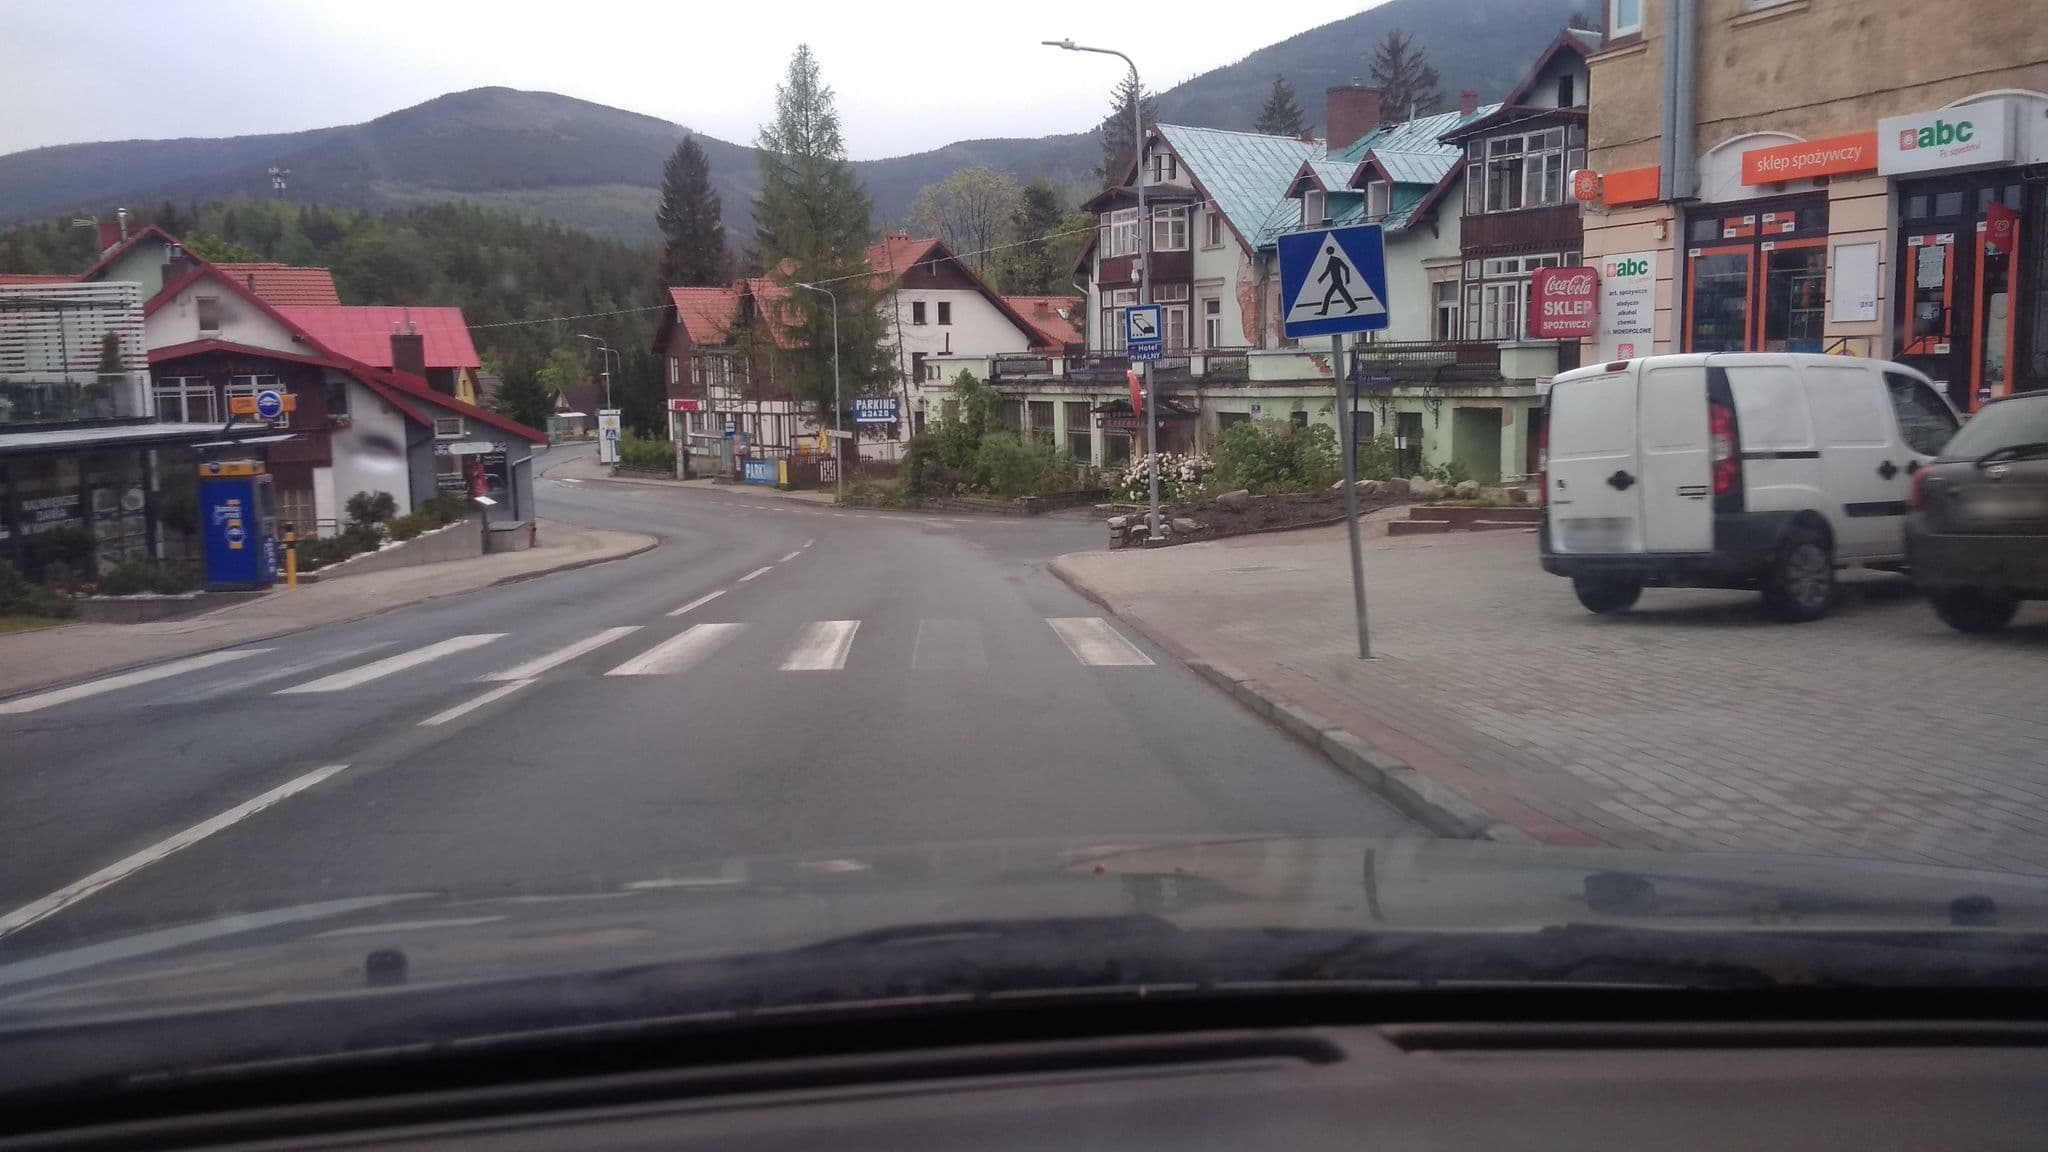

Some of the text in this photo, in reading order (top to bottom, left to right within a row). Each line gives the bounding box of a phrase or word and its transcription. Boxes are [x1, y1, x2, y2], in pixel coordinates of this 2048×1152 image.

[1918, 120, 1974, 149] abc
[1757, 146, 1862, 172] sklep spożywczy
[1616, 258, 1649, 277] abc
[1544, 275, 1593, 296] Coca-Cola
[1544, 301, 1593, 316] SKLEP
[1543, 320, 1592, 330] SPOŻYWCZY
[1138, 343, 1158, 352] Hotel
[1136, 352, 1161, 361] HALNY
[856, 399, 896, 411] PARKING
